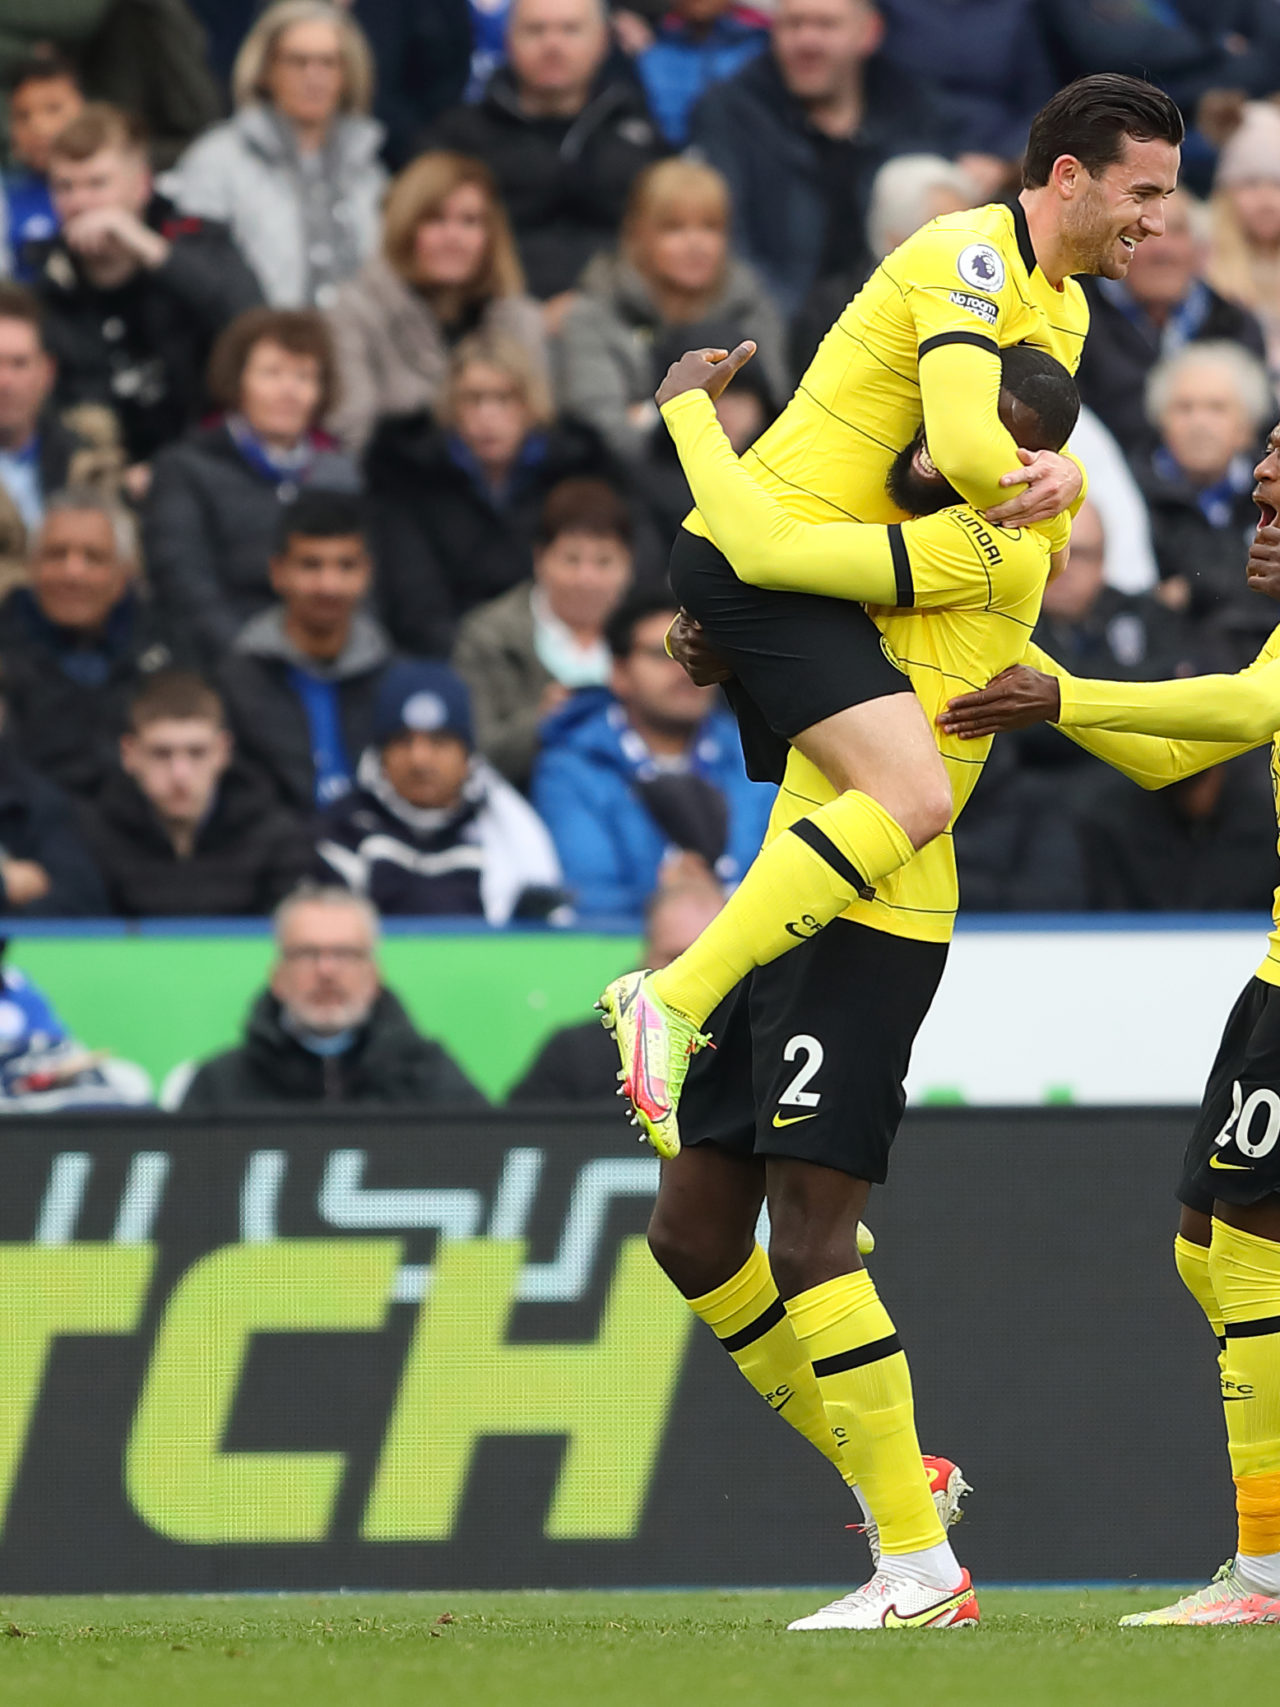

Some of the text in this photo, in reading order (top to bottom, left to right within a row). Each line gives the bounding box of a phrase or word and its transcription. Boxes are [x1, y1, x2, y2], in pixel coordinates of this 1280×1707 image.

[948, 291, 997, 316] No room
[942, 507, 1004, 567] YUNDAI
[801, 914, 824, 932] CF
[777, 1033, 825, 1108] 2
[763, 1383, 791, 1403] FC
